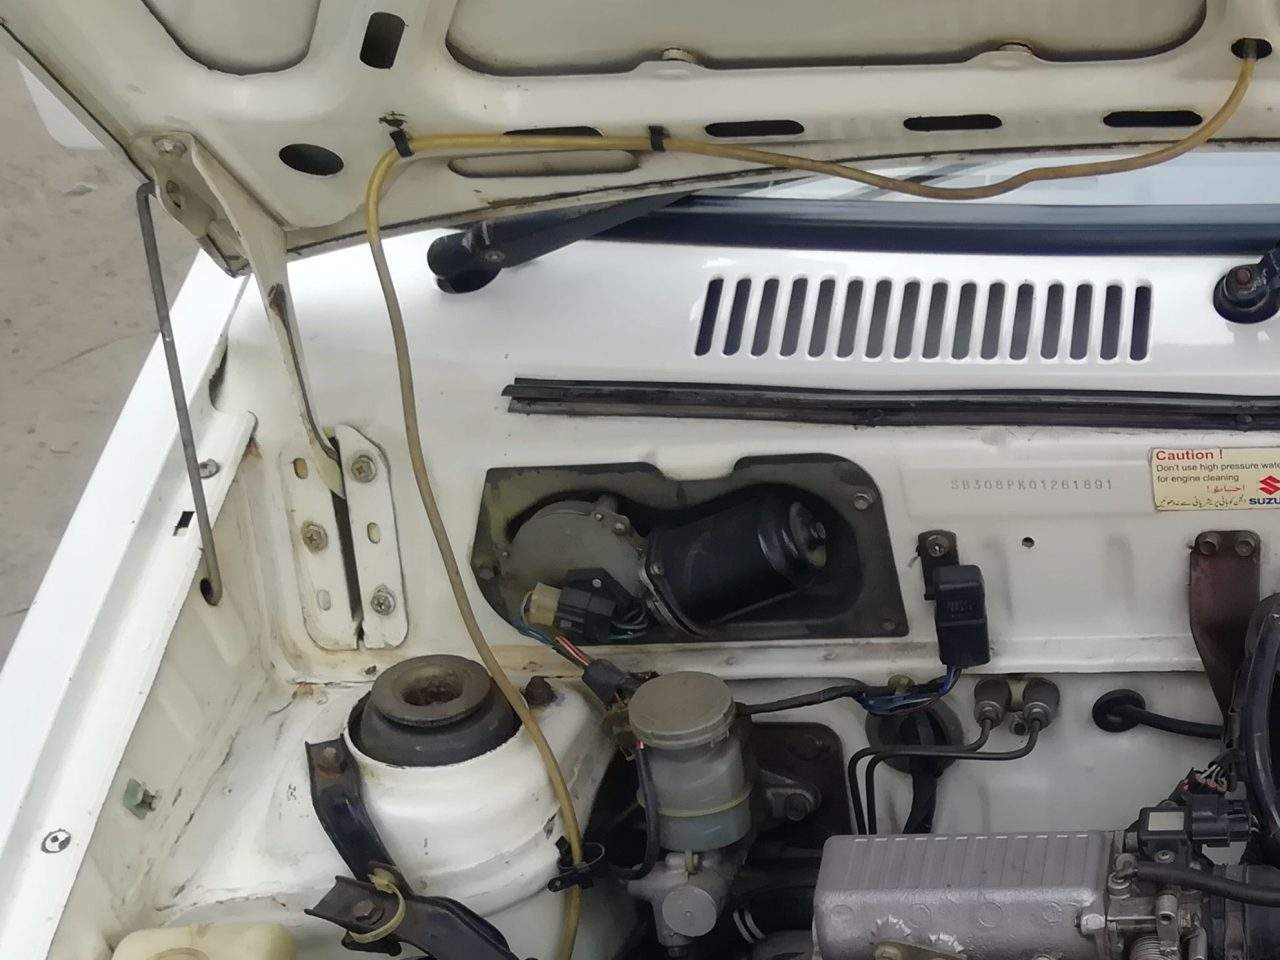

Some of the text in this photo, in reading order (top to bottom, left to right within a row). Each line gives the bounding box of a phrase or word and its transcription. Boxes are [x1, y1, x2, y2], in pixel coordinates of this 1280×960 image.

[1156, 449, 1214, 461] Caution
[1157, 464, 1179, 472] Don't
[1200, 463, 1219, 473] high
[1221, 464, 1260, 473] pressure
[1171, 475, 1200, 484] engine
[1203, 474, 1239, 484] cleaning
